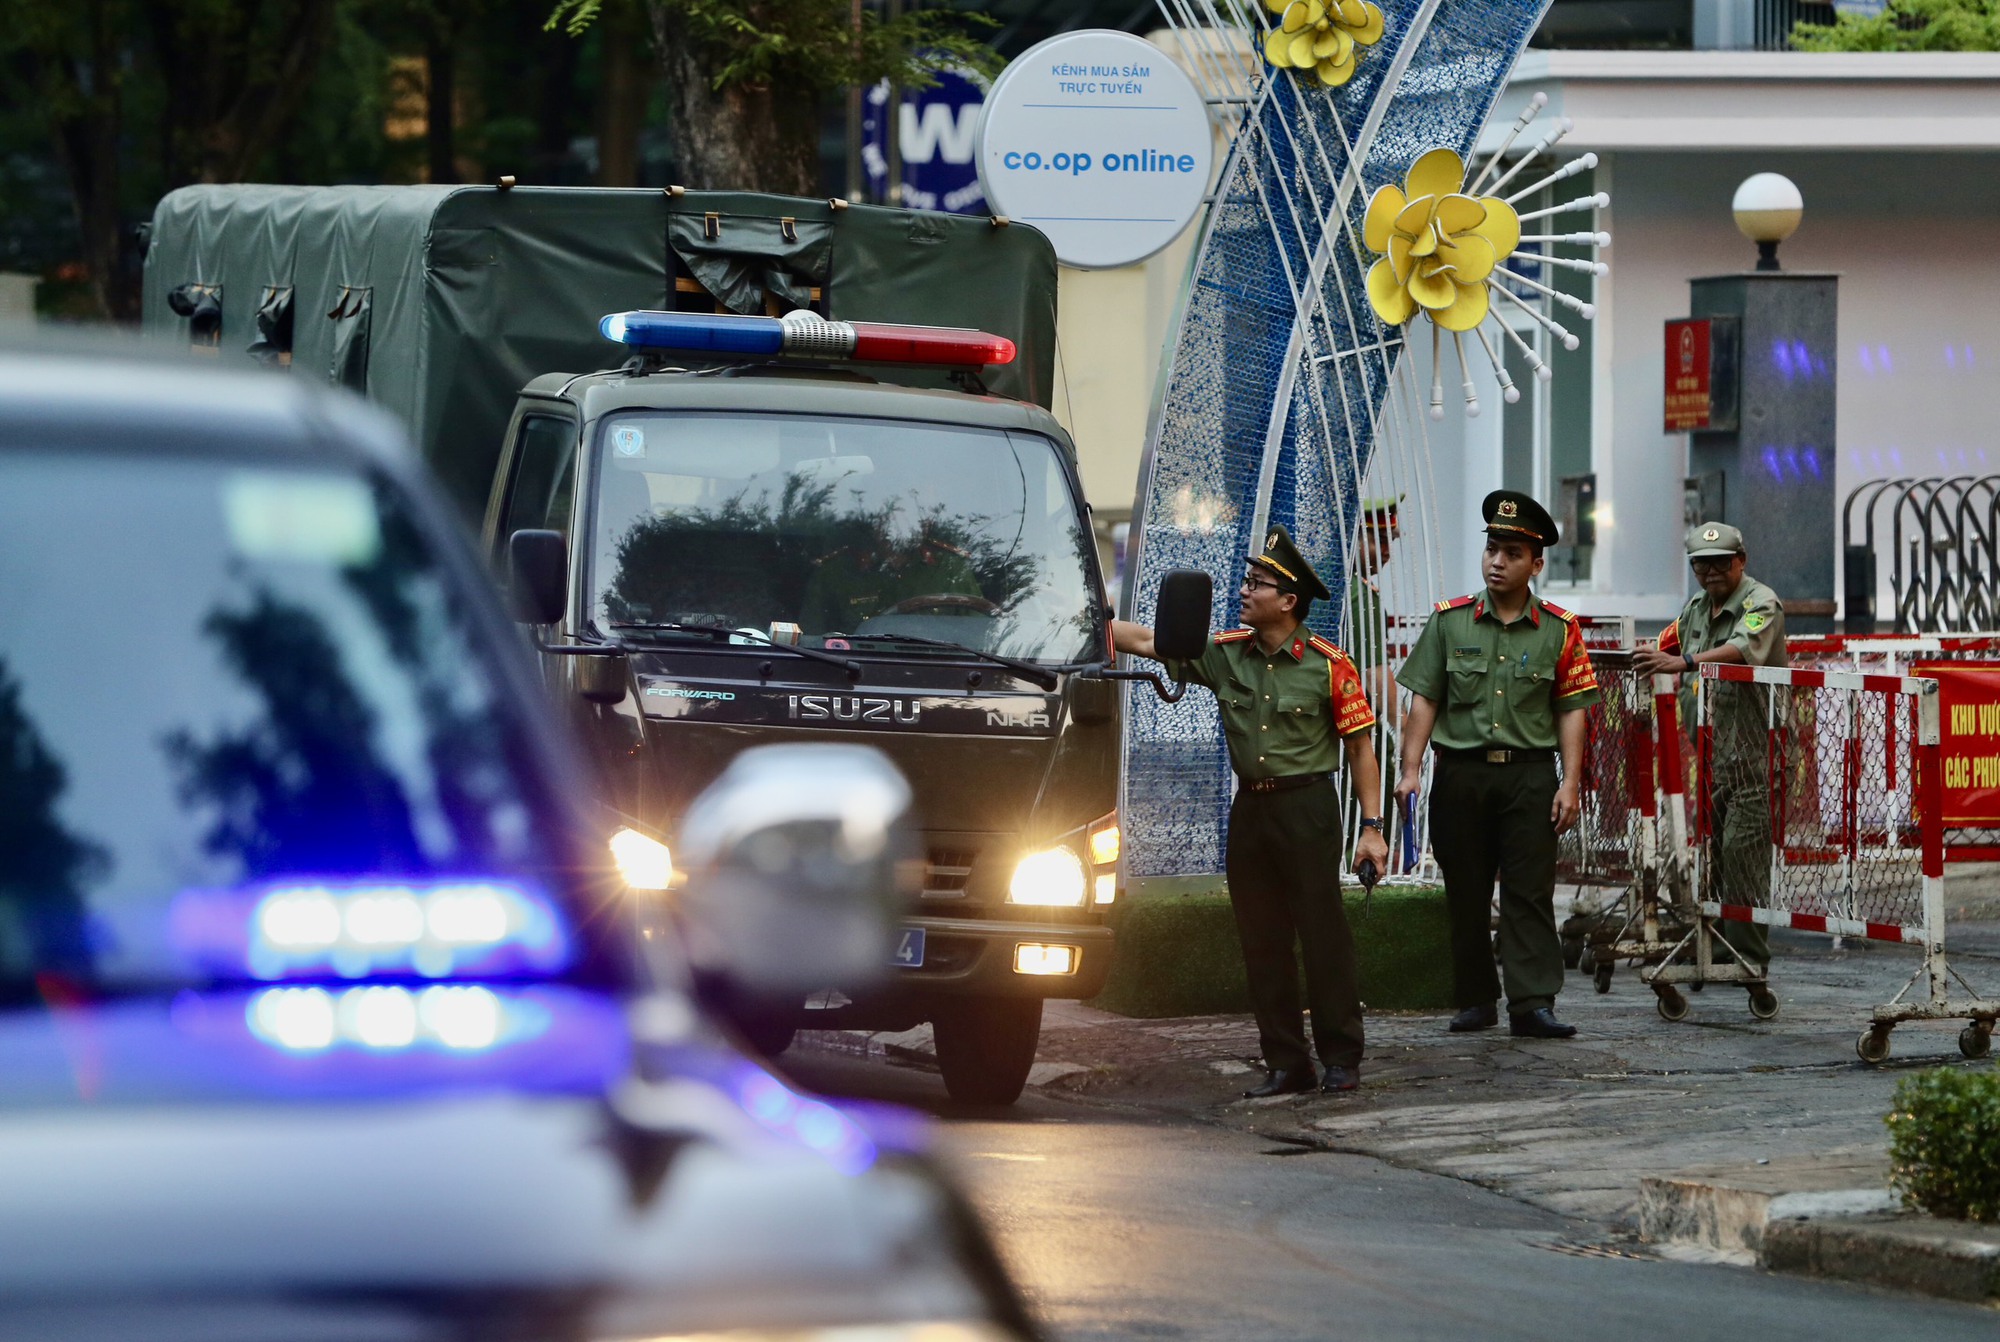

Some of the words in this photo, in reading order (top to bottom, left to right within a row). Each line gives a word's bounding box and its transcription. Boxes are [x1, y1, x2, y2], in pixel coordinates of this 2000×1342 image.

[1051, 63, 1087, 76] KÊNH
[1091, 66, 1119, 77] MUA
[1122, 62, 1150, 78] SẮM
[1059, 82, 1096, 95] TRỰC
[1100, 80, 1142, 94] TUYẾN
[1003, 151, 1092, 176] co.op
[1102, 149, 1195, 173] online
[646, 688, 736, 701] FORWARD
[788, 695, 920, 724] ISUZU
[986, 712, 1050, 728] NKR
[1951, 704, 1976, 736] KHU
[1945, 752, 1970, 789] CÁC
[1973, 752, 2000, 788] PHƯ
